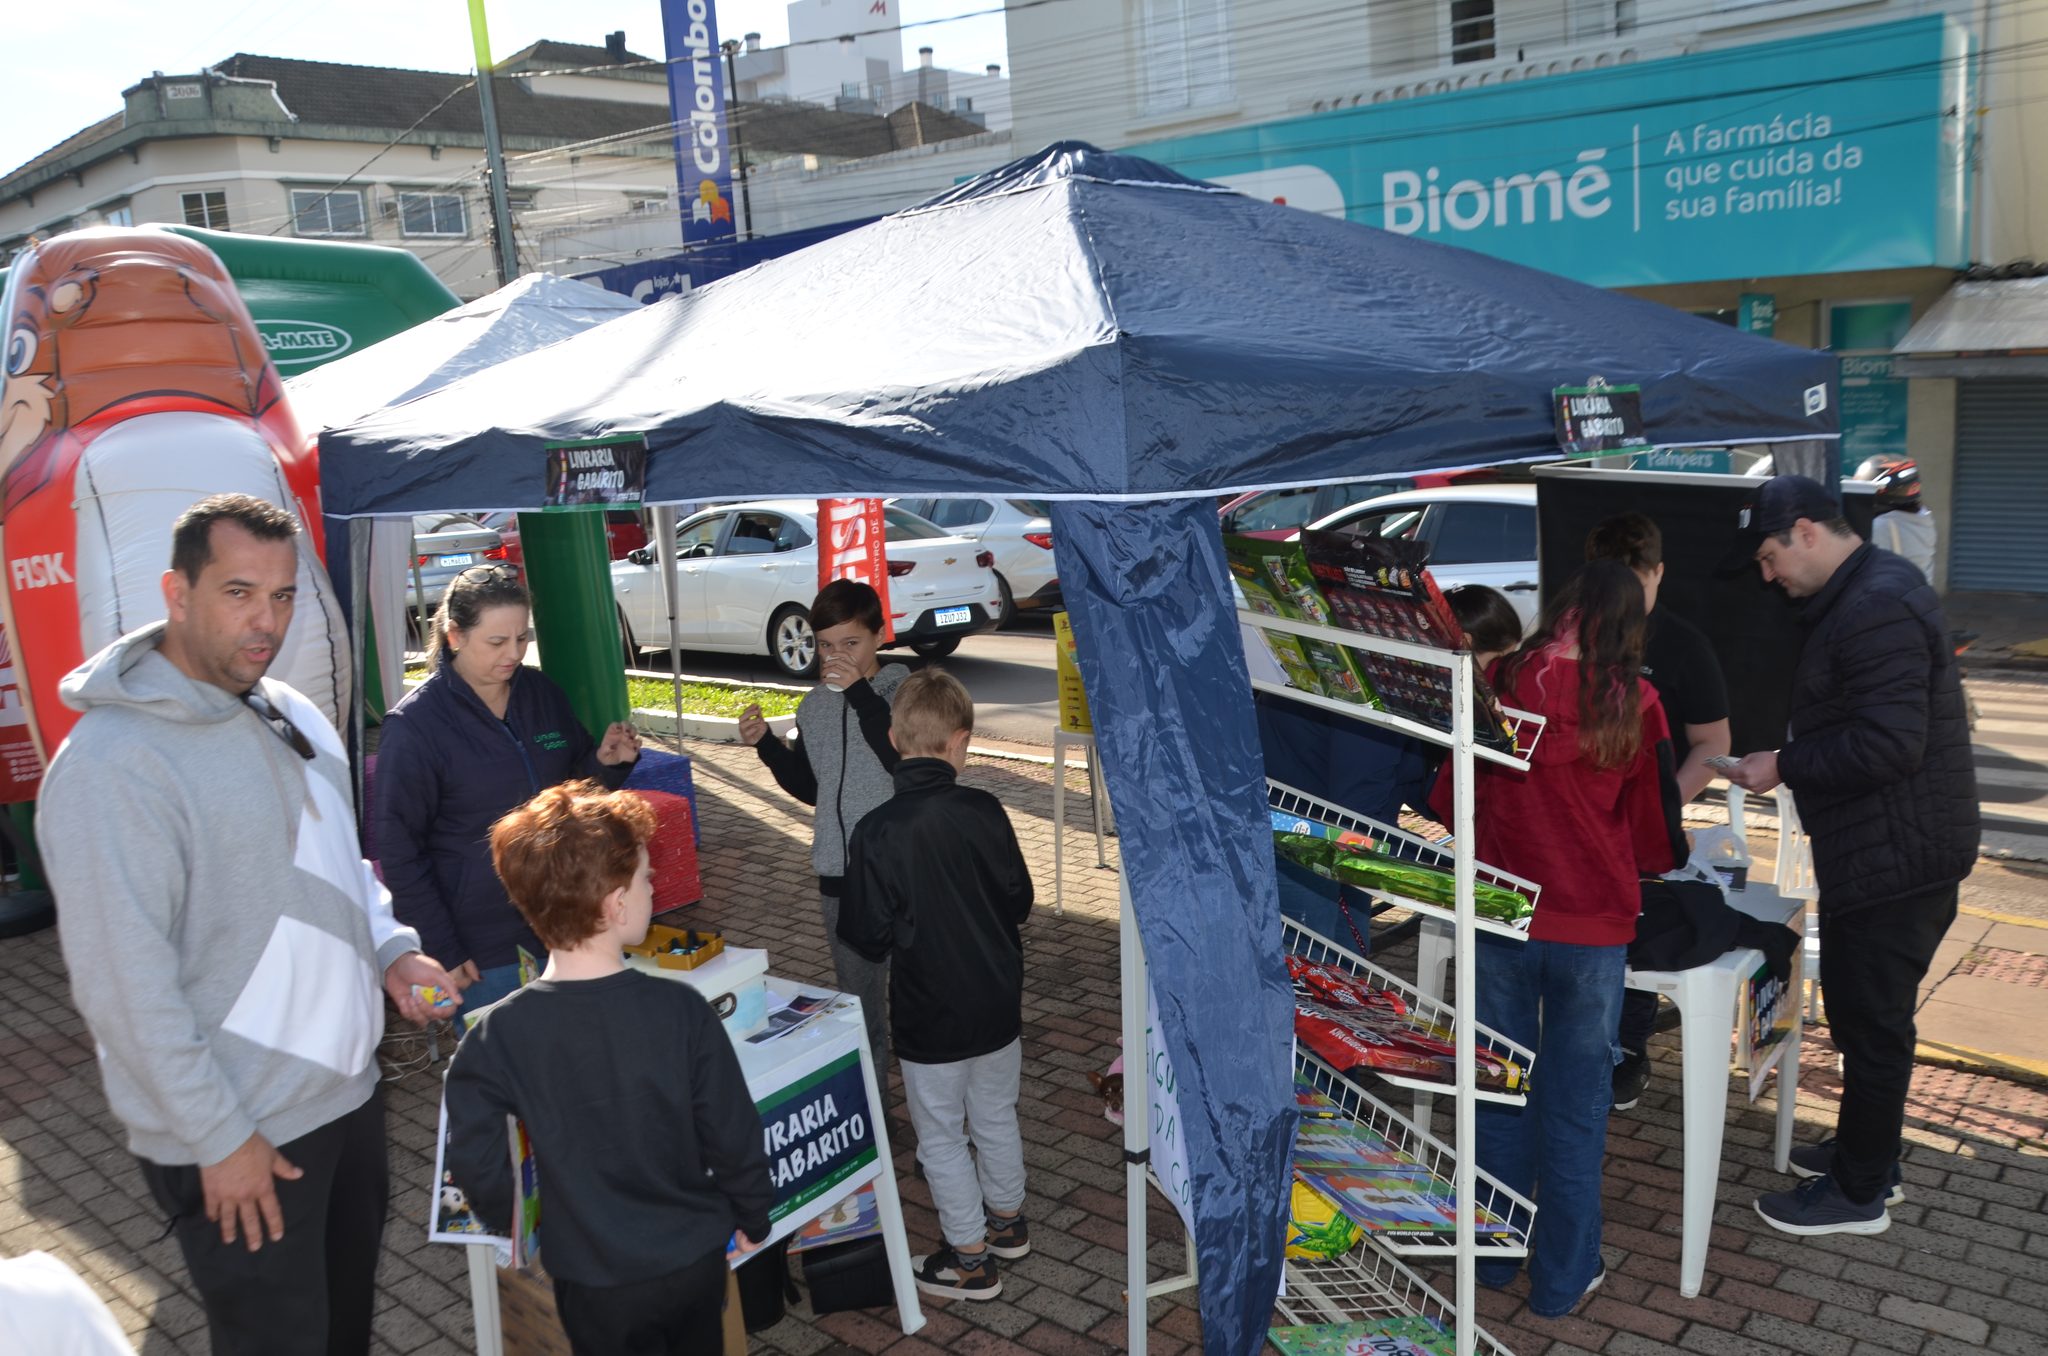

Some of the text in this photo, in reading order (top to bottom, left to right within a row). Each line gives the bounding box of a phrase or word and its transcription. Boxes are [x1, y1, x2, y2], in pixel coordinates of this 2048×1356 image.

[684, 0, 720, 174] Colombo
[1664, 112, 1832, 157] A farmácia
[1665, 140, 1863, 194] que cuida da
[1665, 176, 1842, 221] sua família!
[1841, 357, 1895, 376] Biom
[1570, 396, 1614, 417] LIVRARIA
[1580, 417, 1625, 438] GABARITO
[568, 447, 616, 469] LIVRARIA
[1647, 451, 1714, 470] Pampers
[576, 469, 625, 491] GABARITO
[872, 518, 880, 535] DE
[10, 551, 75, 592] FISK
[872, 541, 881, 587] CENTRO
[1145, 1027, 1180, 1105] FIGU
[1154, 1102, 1176, 1152] DA
